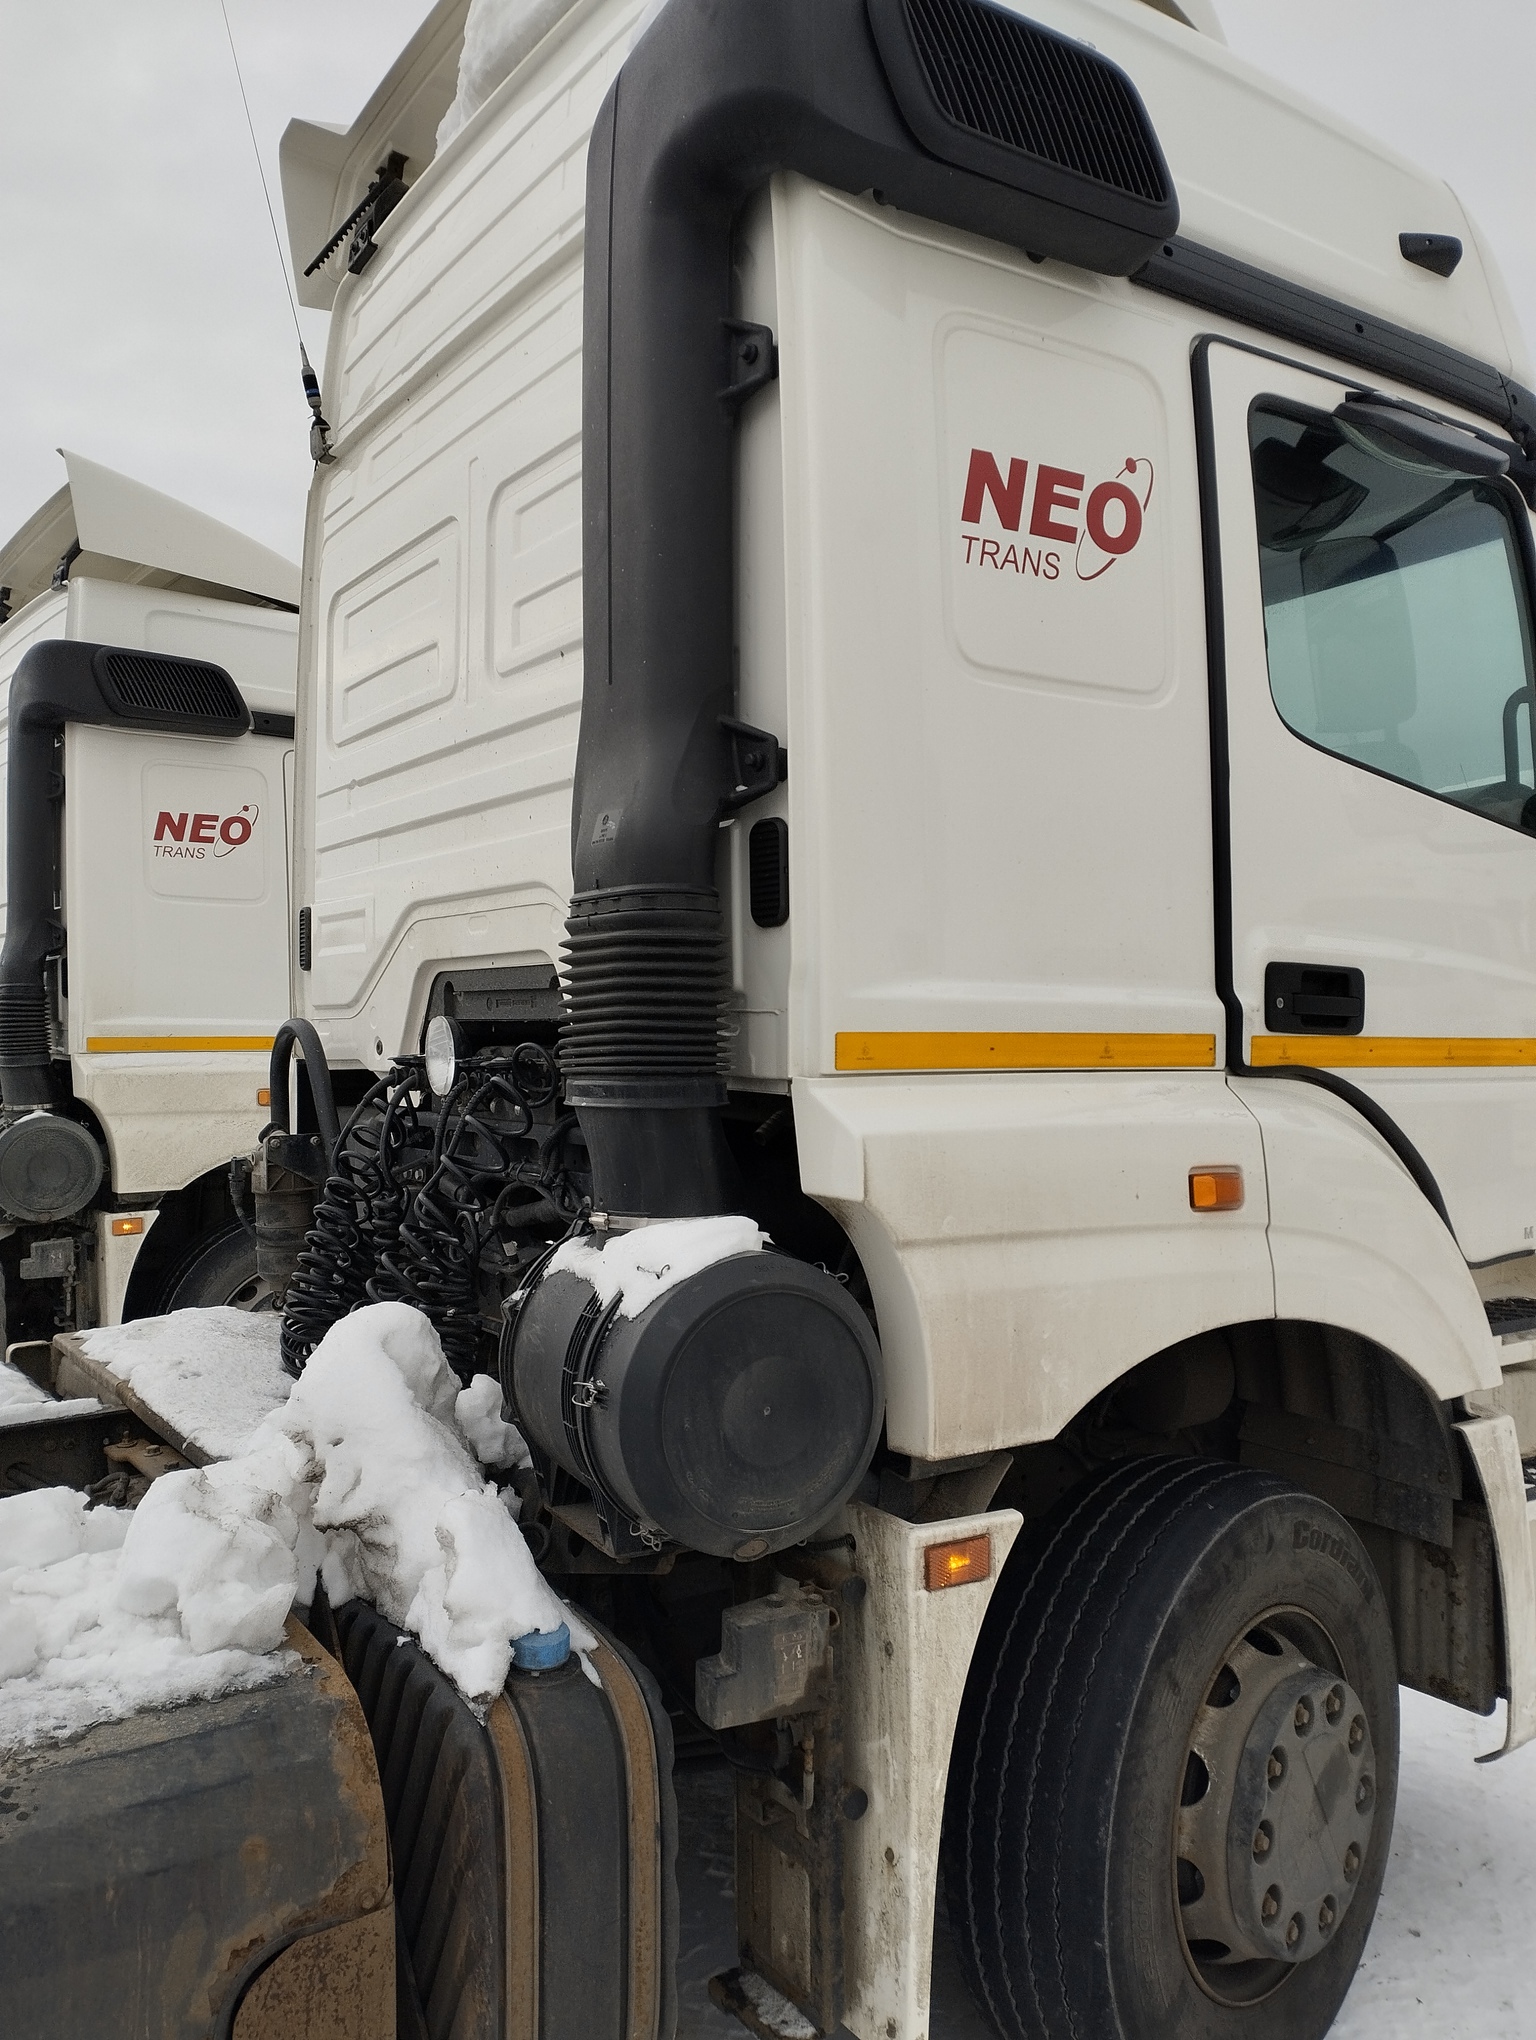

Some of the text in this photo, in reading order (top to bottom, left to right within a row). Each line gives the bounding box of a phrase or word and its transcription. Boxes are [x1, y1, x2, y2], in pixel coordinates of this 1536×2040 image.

[961, 449, 1143, 555] NEO
[961, 535, 1061, 581] TRANS
[153, 811, 253, 847] NEO
[153, 845, 206, 859] TRANS
